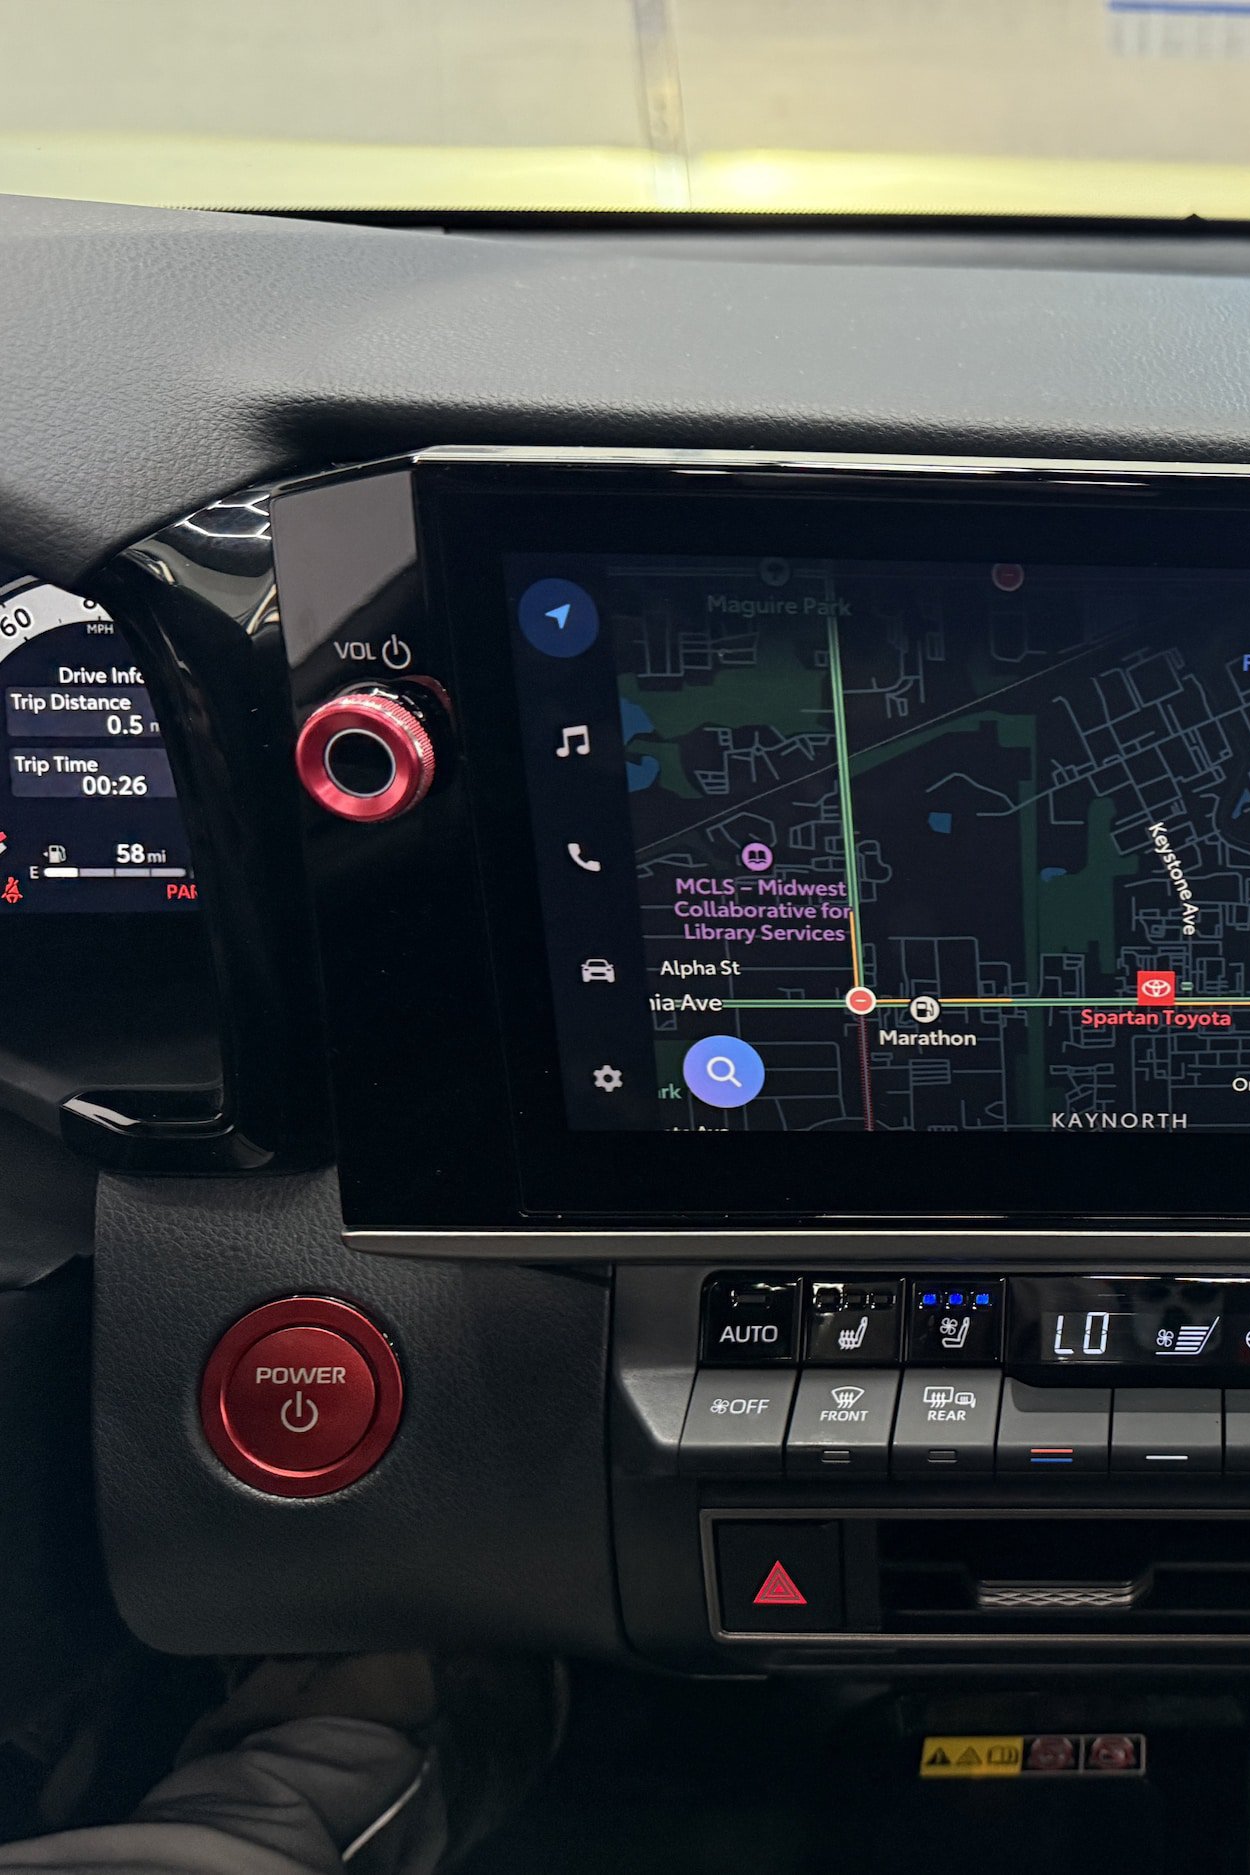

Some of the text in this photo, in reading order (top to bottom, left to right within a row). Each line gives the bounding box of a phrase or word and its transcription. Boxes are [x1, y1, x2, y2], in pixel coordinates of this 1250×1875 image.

[707, 594, 852, 616] Maguire Park
[0, 608, 32, 637] 60
[87, 624, 114, 635] MPH
[333, 641, 377, 660] VOL
[58, 666, 107, 684] Drive
[10, 693, 132, 714] Trip Distance
[107, 715, 143, 736] 0.5
[14, 756, 99, 777] Trip Time
[82, 775, 147, 797] 00:26
[116, 843, 167, 864] 58 mi
[29, 866, 40, 880] E
[1148, 822, 1200, 937] Keystone Ave
[675, 878, 737, 896] MCLS
[757, 879, 848, 897] Midwest
[673, 901, 851, 919] Collaborative for
[684, 924, 846, 945] Library Services
[660, 960, 742, 981] Alpha St
[680, 993, 723, 1012] Ave
[1080, 1008, 1232, 1029] Spartan Toyota
[879, 1029, 977, 1046] Marathon
[1051, 1112, 1188, 1130] KAYNORTH
[719, 1325, 779, 1344] AUTO
[255, 1366, 347, 1385] POWER
[729, 1399, 770, 1415] OFF
[819, 1409, 869, 1422] FRONT
[926, 1409, 967, 1423] REAR
